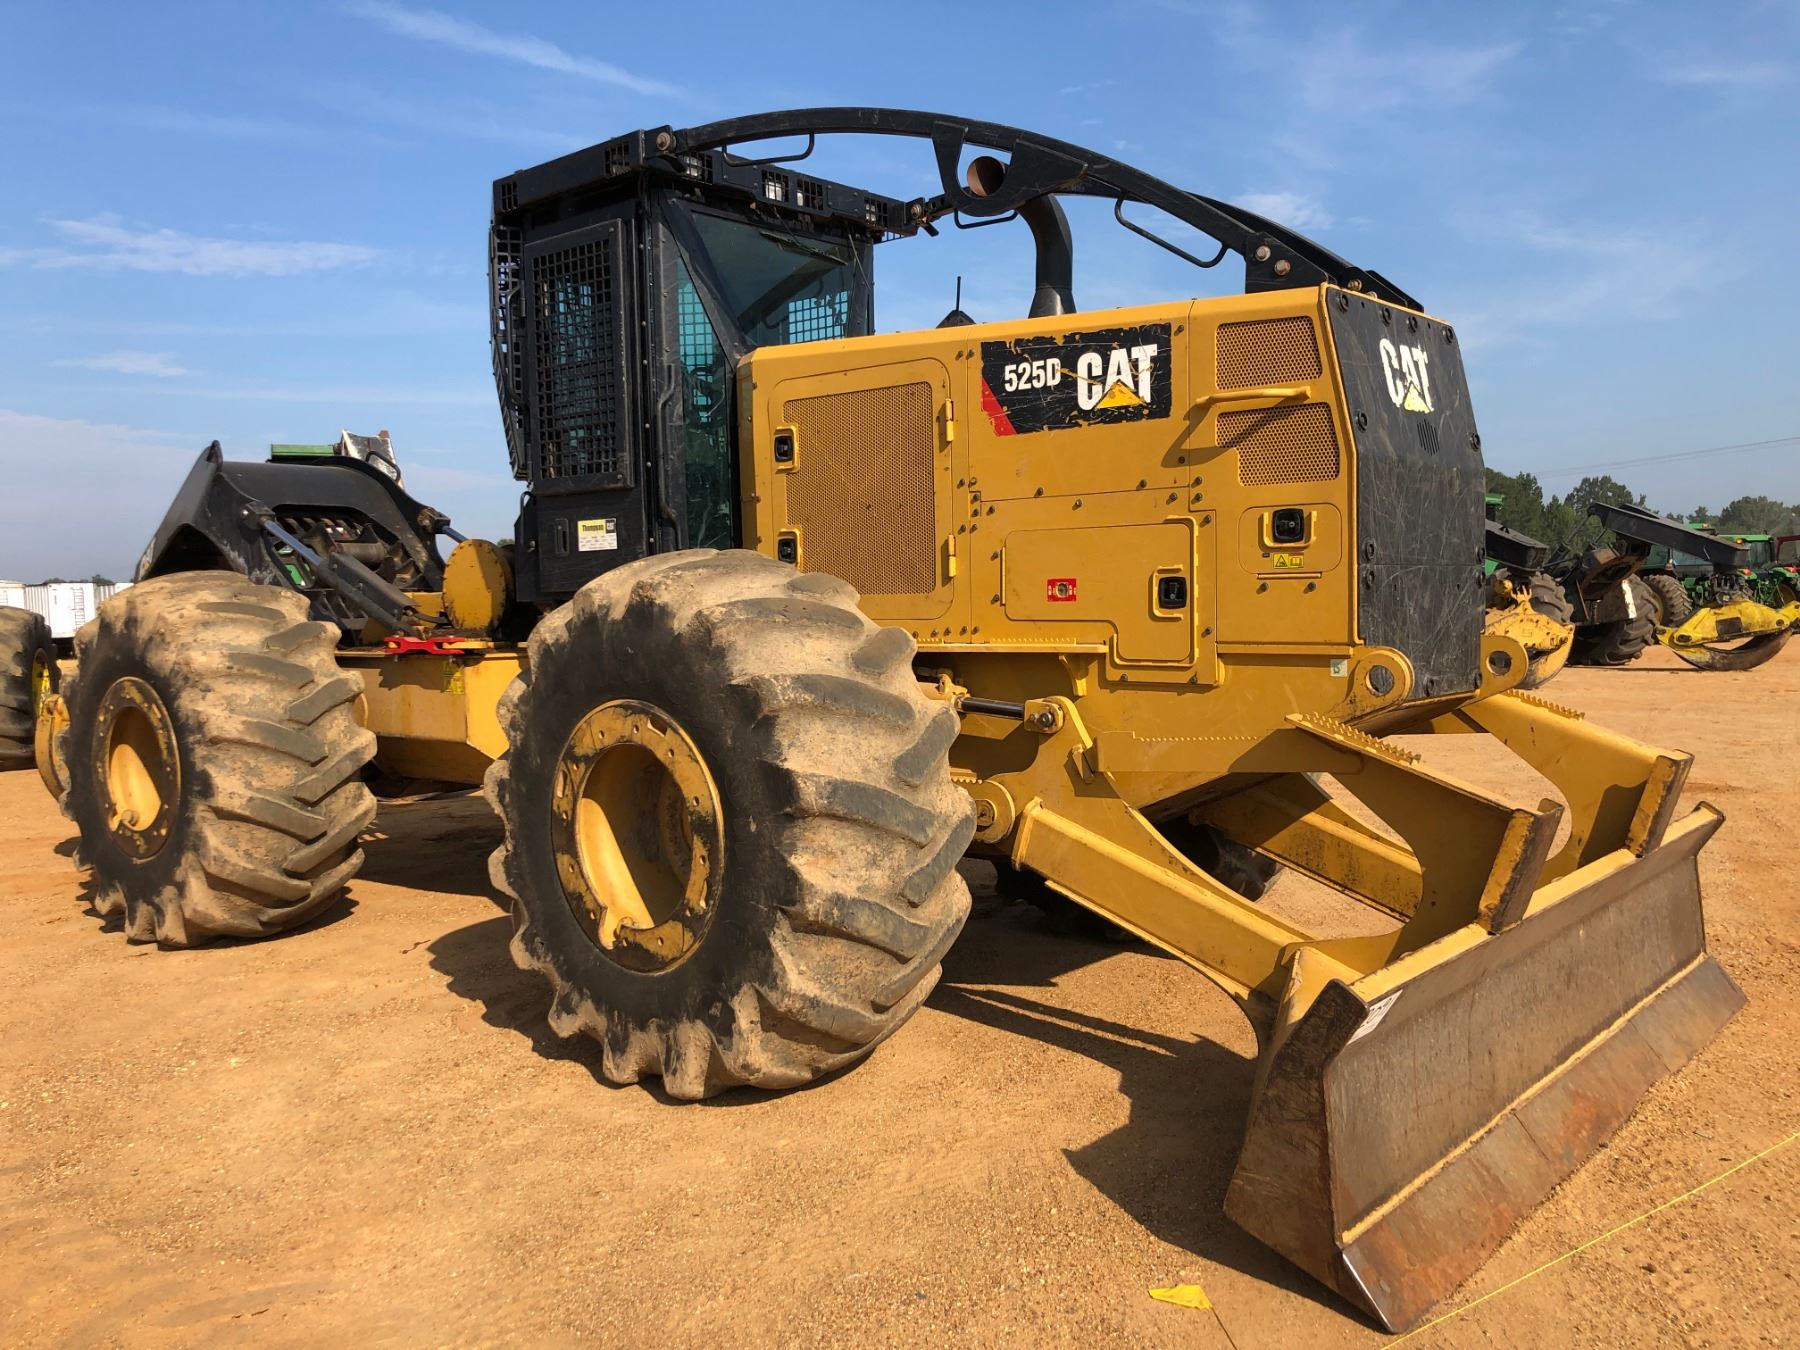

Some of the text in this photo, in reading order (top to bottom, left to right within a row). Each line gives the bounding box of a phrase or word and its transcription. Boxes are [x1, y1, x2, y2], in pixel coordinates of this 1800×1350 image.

[1004, 344, 1158, 411] 525D CAT
[1379, 338, 1434, 412] CAT
